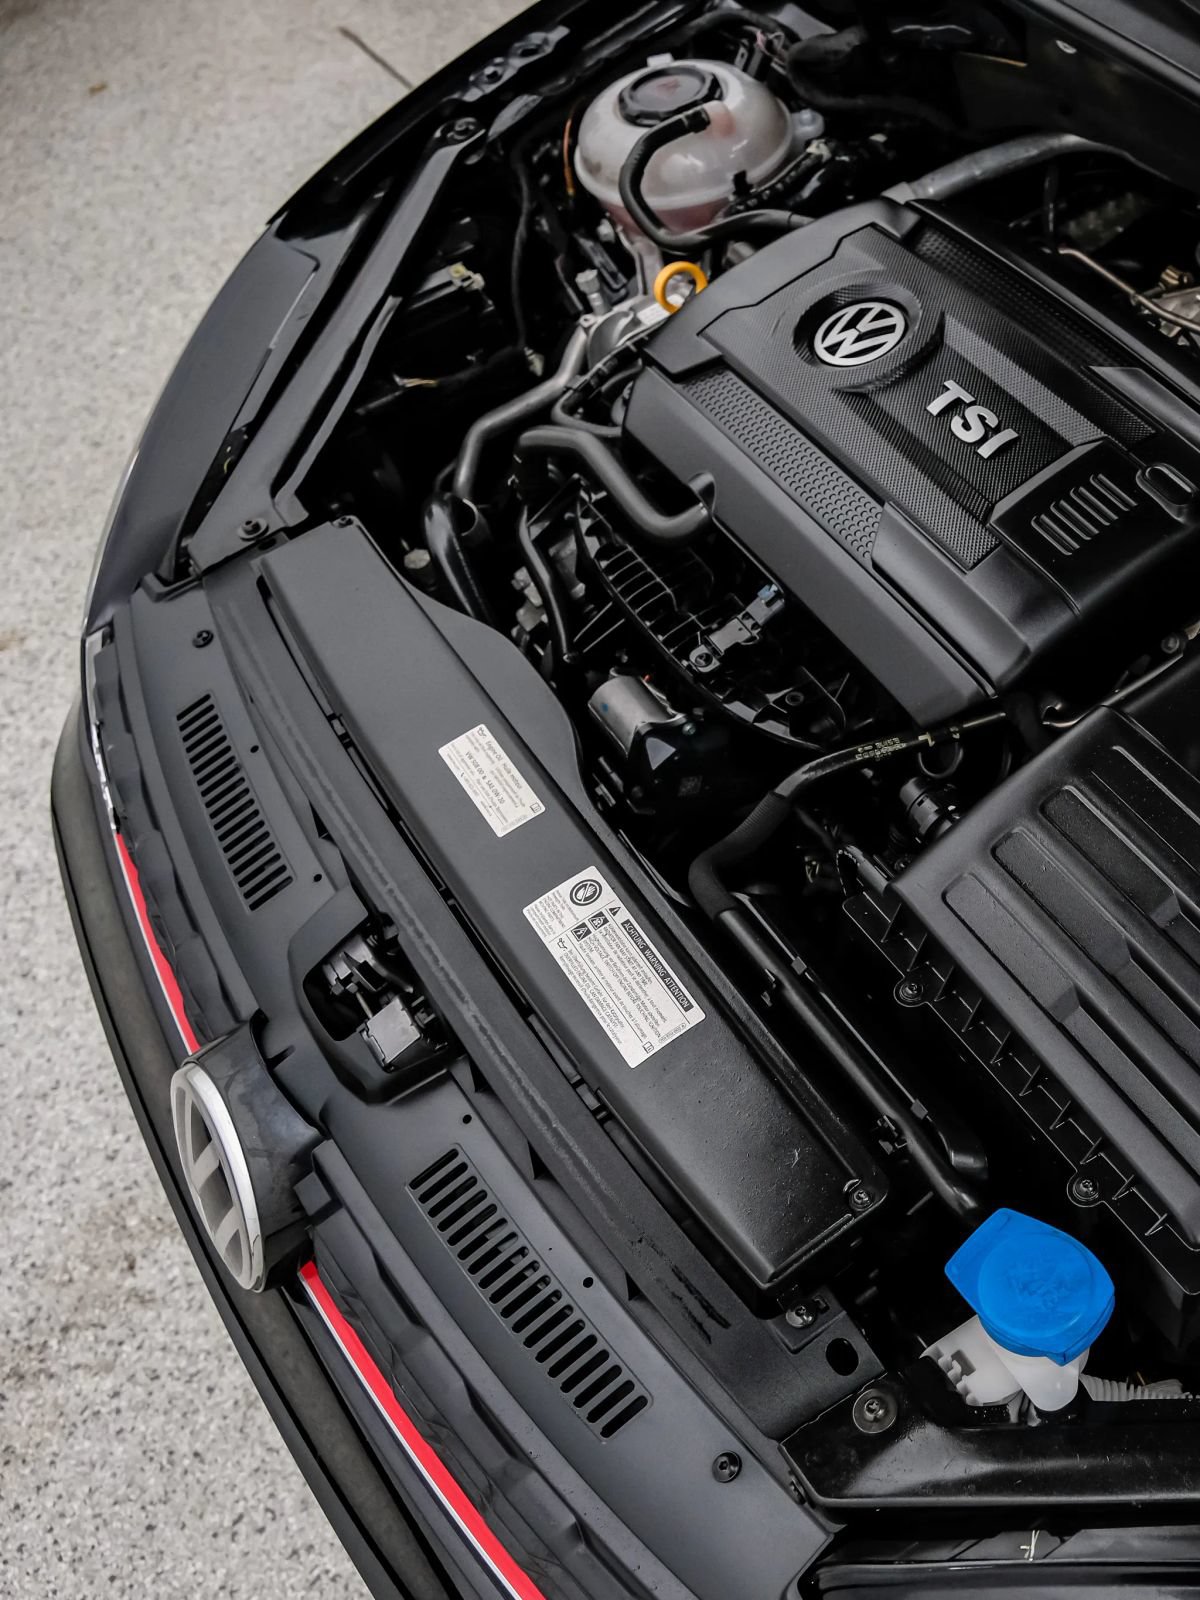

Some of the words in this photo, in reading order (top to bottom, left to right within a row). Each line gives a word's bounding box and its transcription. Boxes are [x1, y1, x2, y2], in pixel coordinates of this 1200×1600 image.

[926, 380, 1019, 459] TSI
[465, 751, 474, 760] VW
[486, 780, 495, 789] SAE
[624, 923, 646, 949] ACHTUNG
[644, 949, 666, 976] WARNING
[664, 977, 689, 1007] ATTENTION
